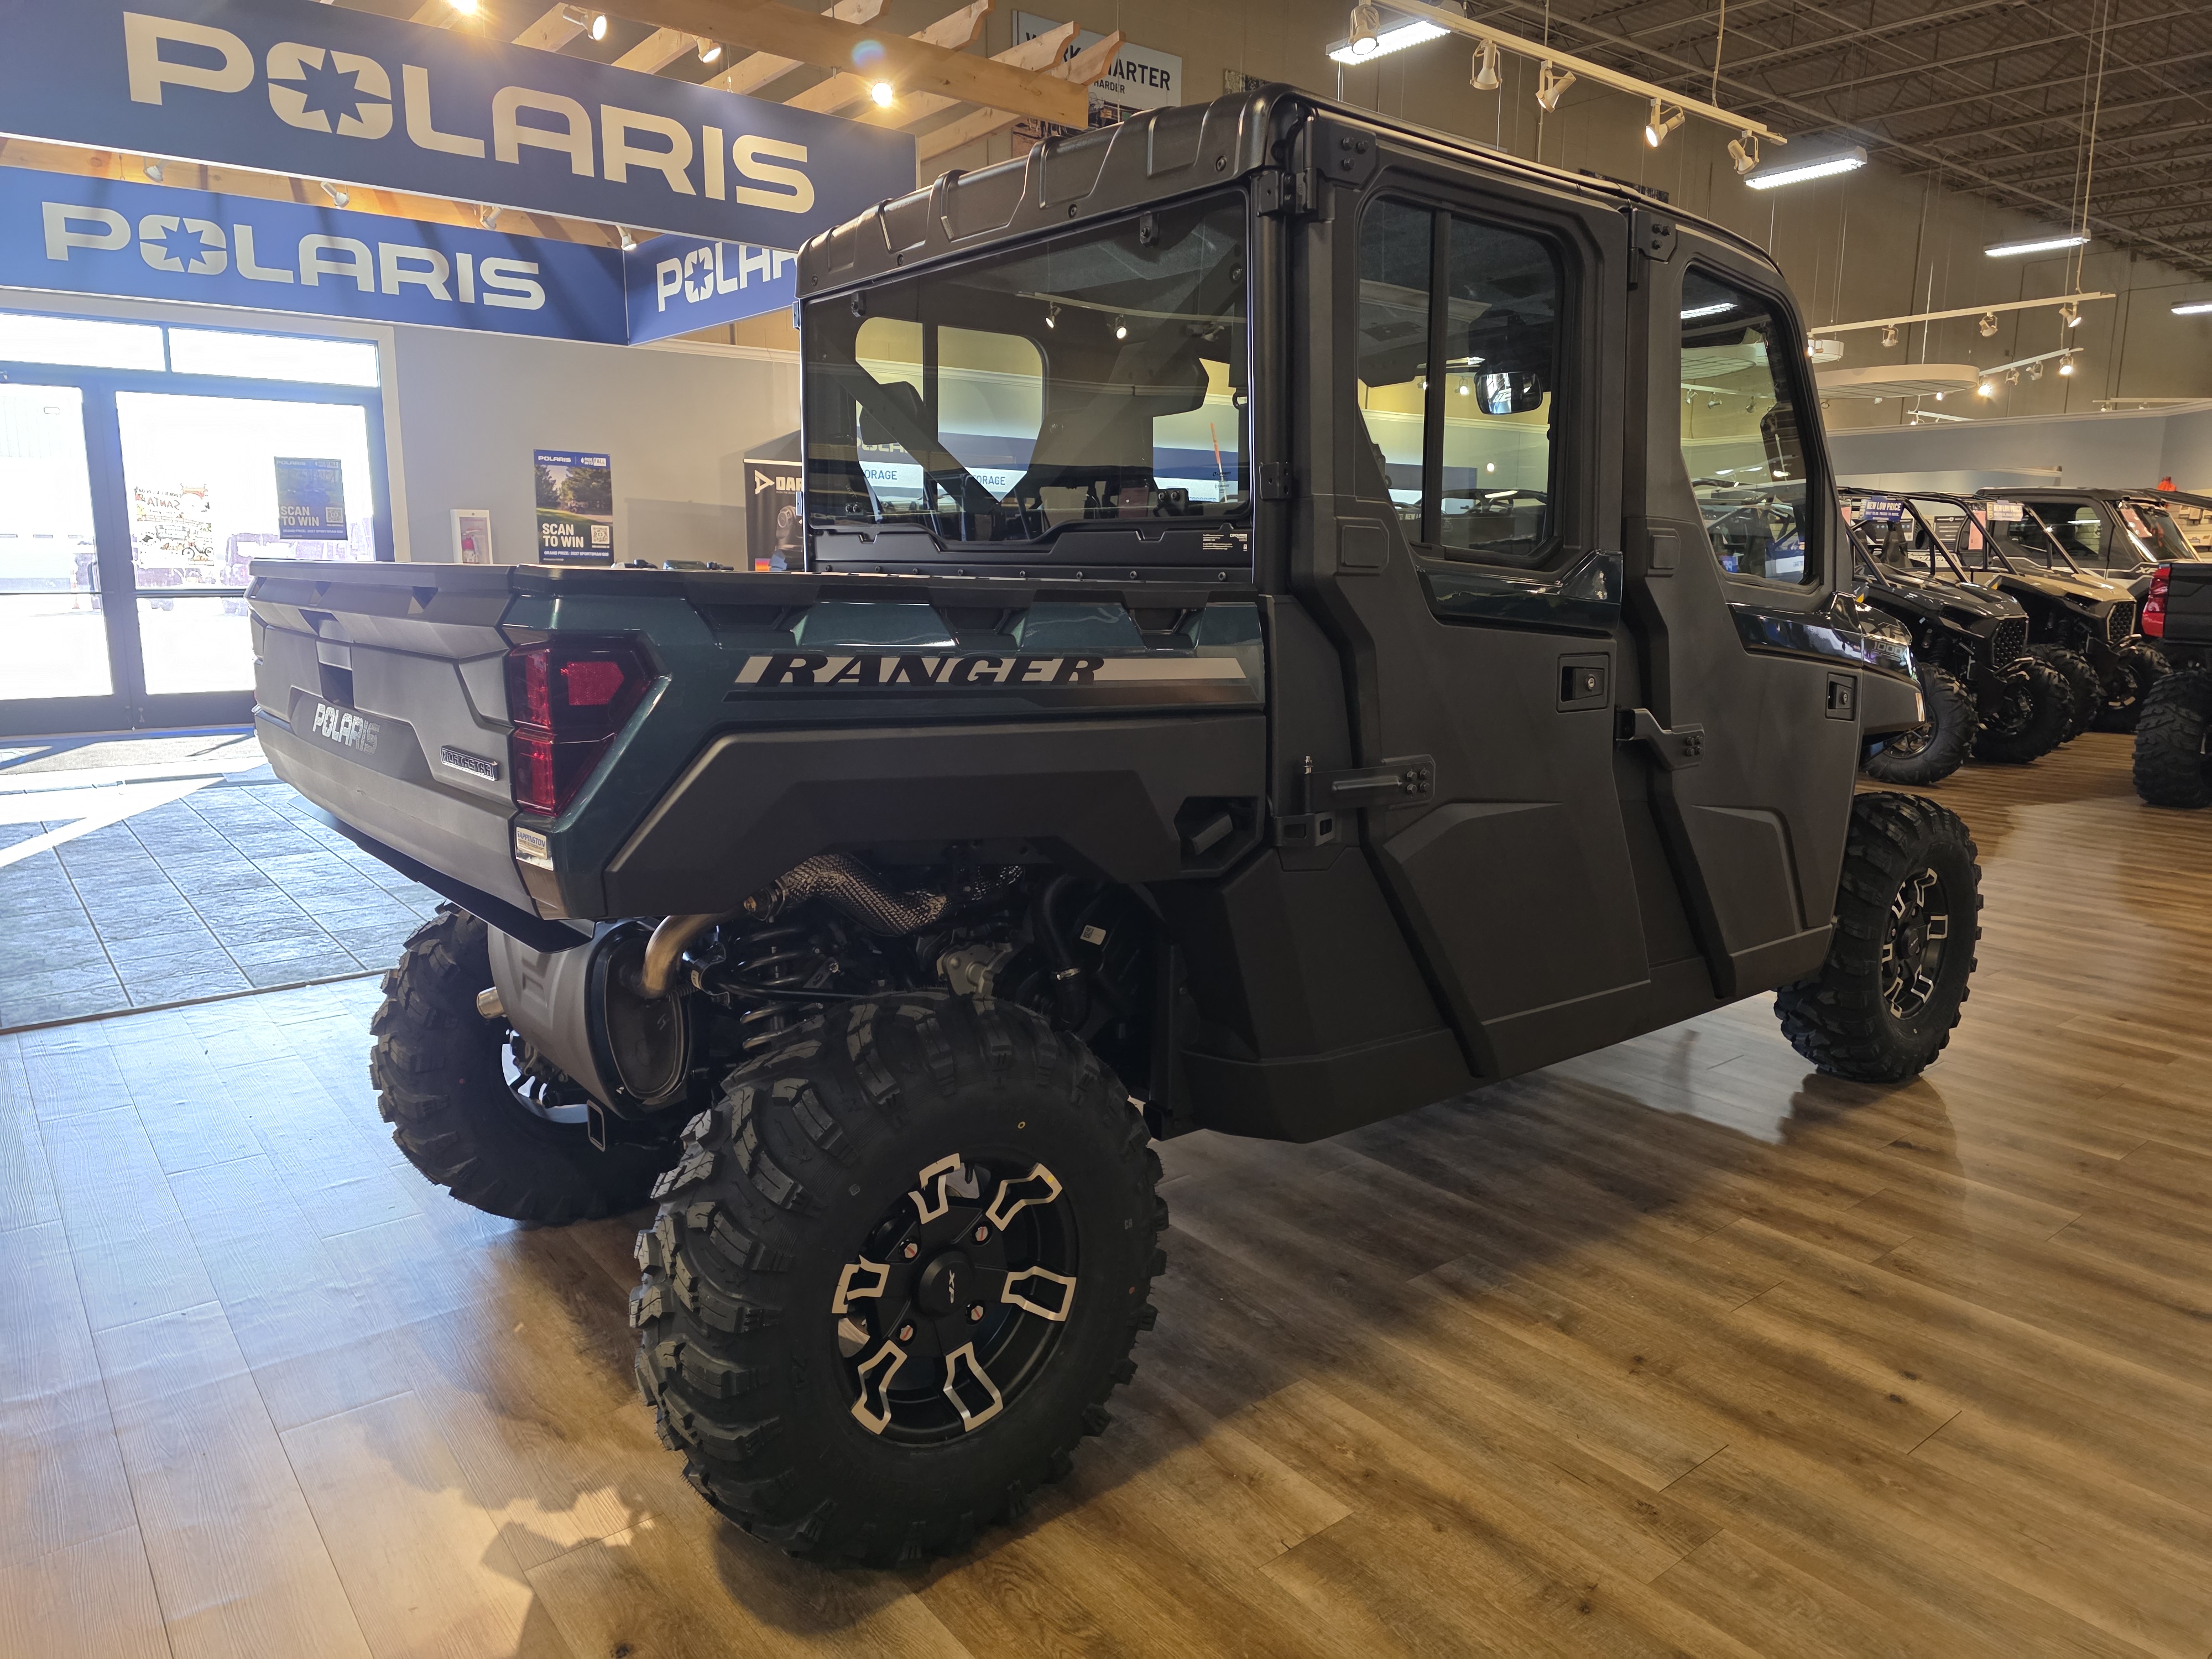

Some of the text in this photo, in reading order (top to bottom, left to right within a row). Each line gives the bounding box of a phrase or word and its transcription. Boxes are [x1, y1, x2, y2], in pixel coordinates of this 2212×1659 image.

[123, 11, 815, 214] POLARIS
[42, 201, 545, 310] POLARIS
[973, 475, 1006, 485] ORAGE
[280, 505, 310, 515] SCAN
[1877, 502, 1887, 510] LOW
[1887, 503, 1901, 511] PRICE
[281, 516, 320, 526] TO WIN
[542, 523, 575, 535] SCAN
[542, 535, 584, 548] TO WIN
[1874, 641, 1903, 655] 1000
[755, 653, 1105, 687] RANGER
[312, 703, 380, 755] POLARIS
[441, 749, 492, 776] NORTHSTAR
[517, 831, 545, 847] SAPPINGTON
